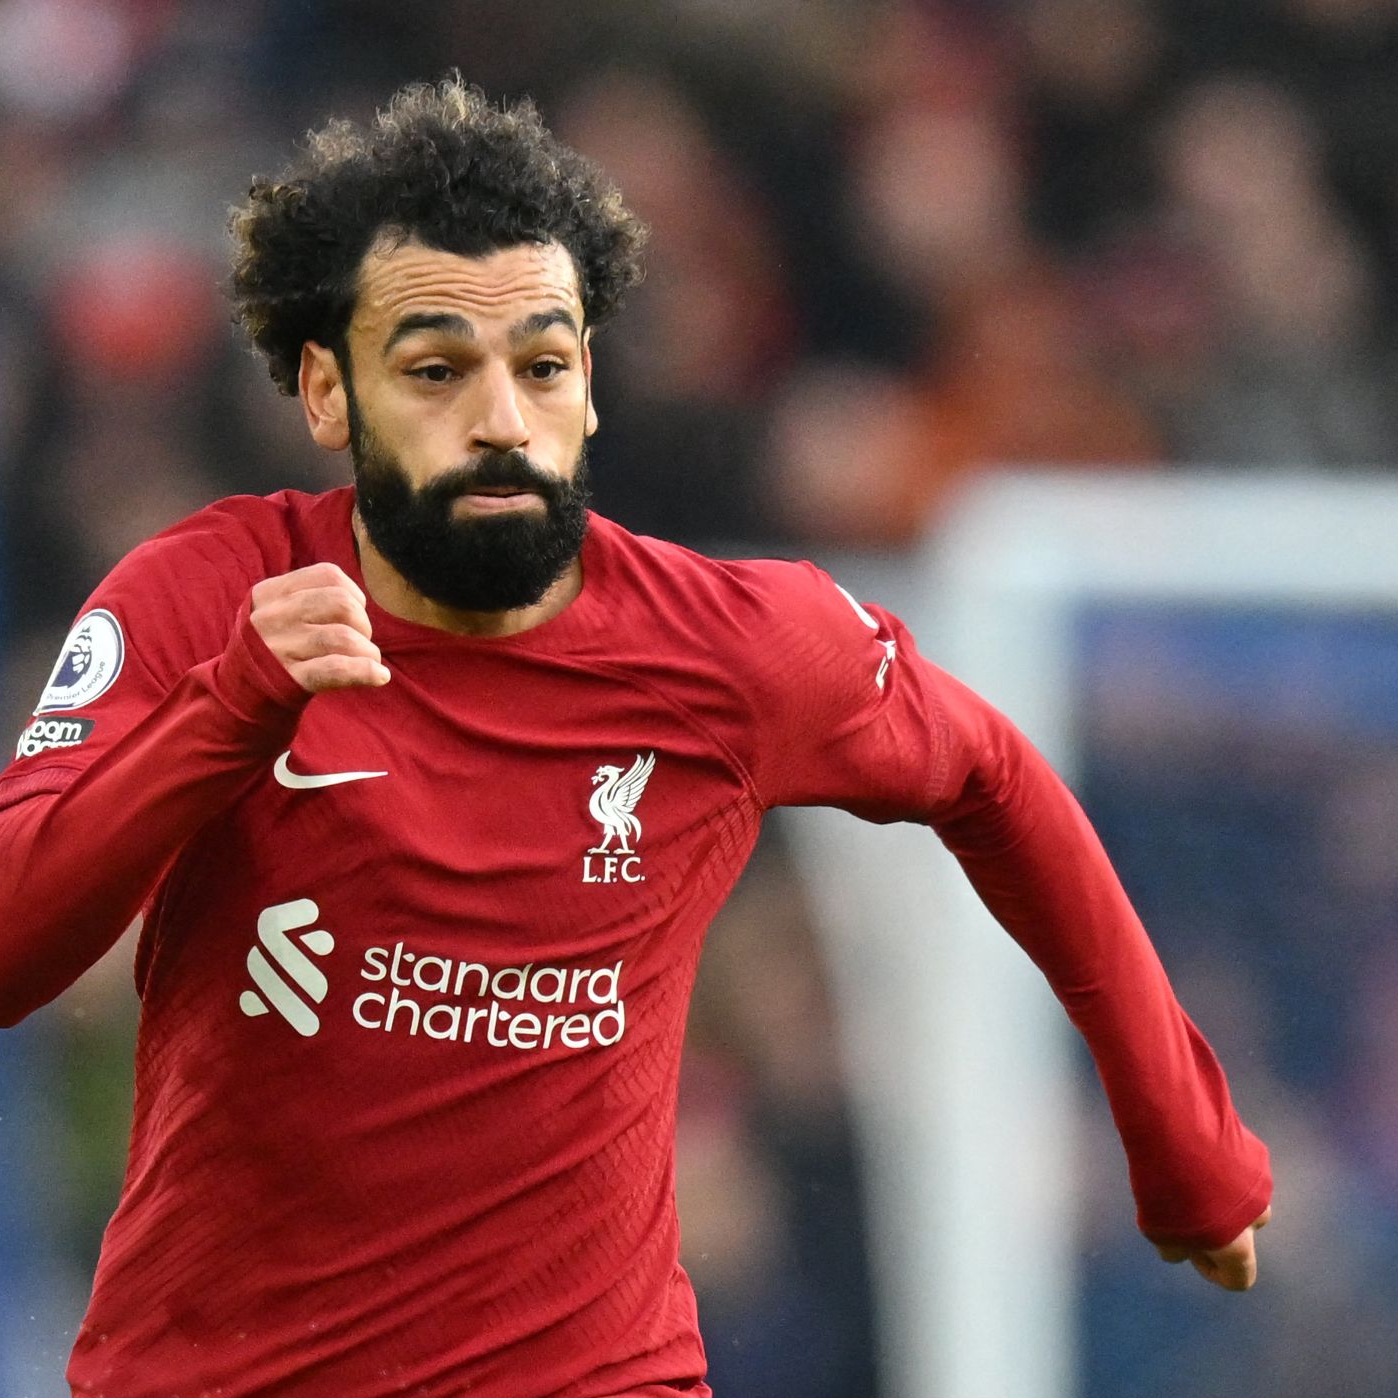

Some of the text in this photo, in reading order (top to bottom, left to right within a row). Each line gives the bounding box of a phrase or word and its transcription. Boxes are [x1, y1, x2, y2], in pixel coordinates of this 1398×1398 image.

[81, 661, 106, 693] League
[359, 941, 624, 1005] standard
[352, 987, 626, 1049] chartered
